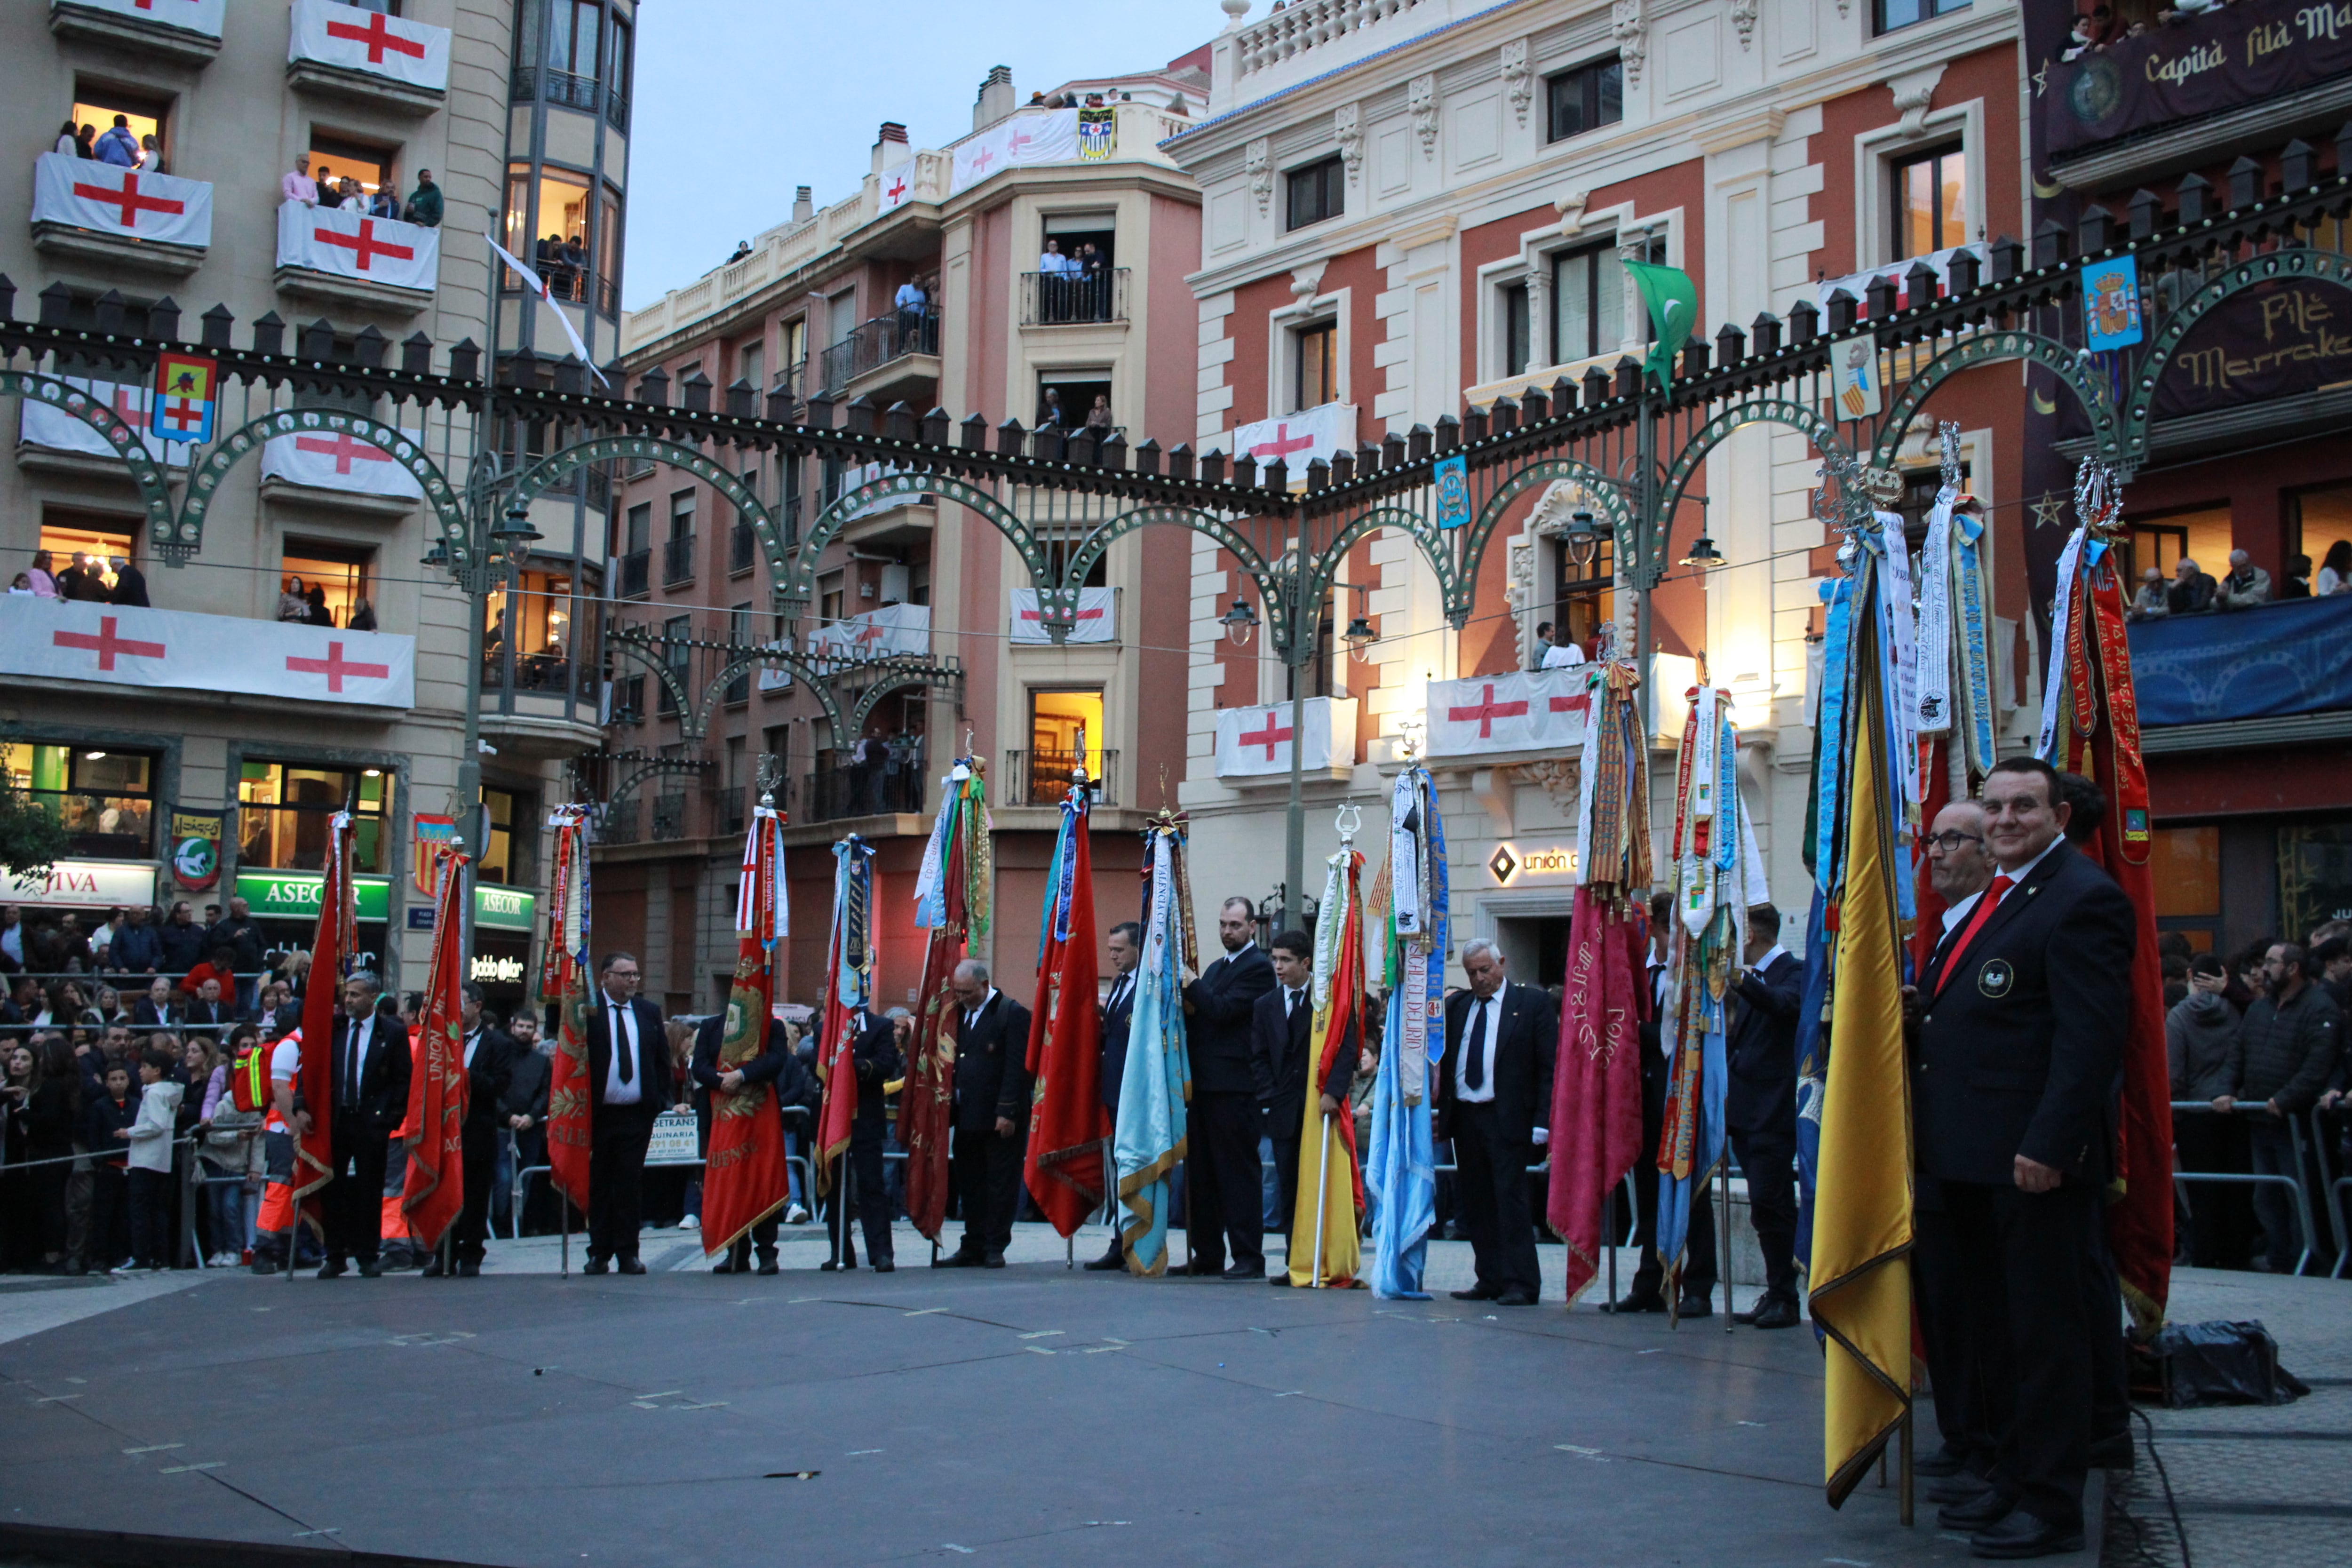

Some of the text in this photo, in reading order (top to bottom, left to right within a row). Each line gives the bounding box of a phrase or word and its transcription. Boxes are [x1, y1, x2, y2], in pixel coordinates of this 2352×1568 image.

[2145, 40, 2227, 87] Capità
[2069, 580, 2084, 675] BERBERISCO
[1523, 849, 1566, 869] unión
[265, 883, 362, 905] ASECR
[482, 893, 521, 915] ASECOR
[1156, 864, 1167, 929] VALENCIA C.F.
[429, 1029, 443, 1082] UNION
